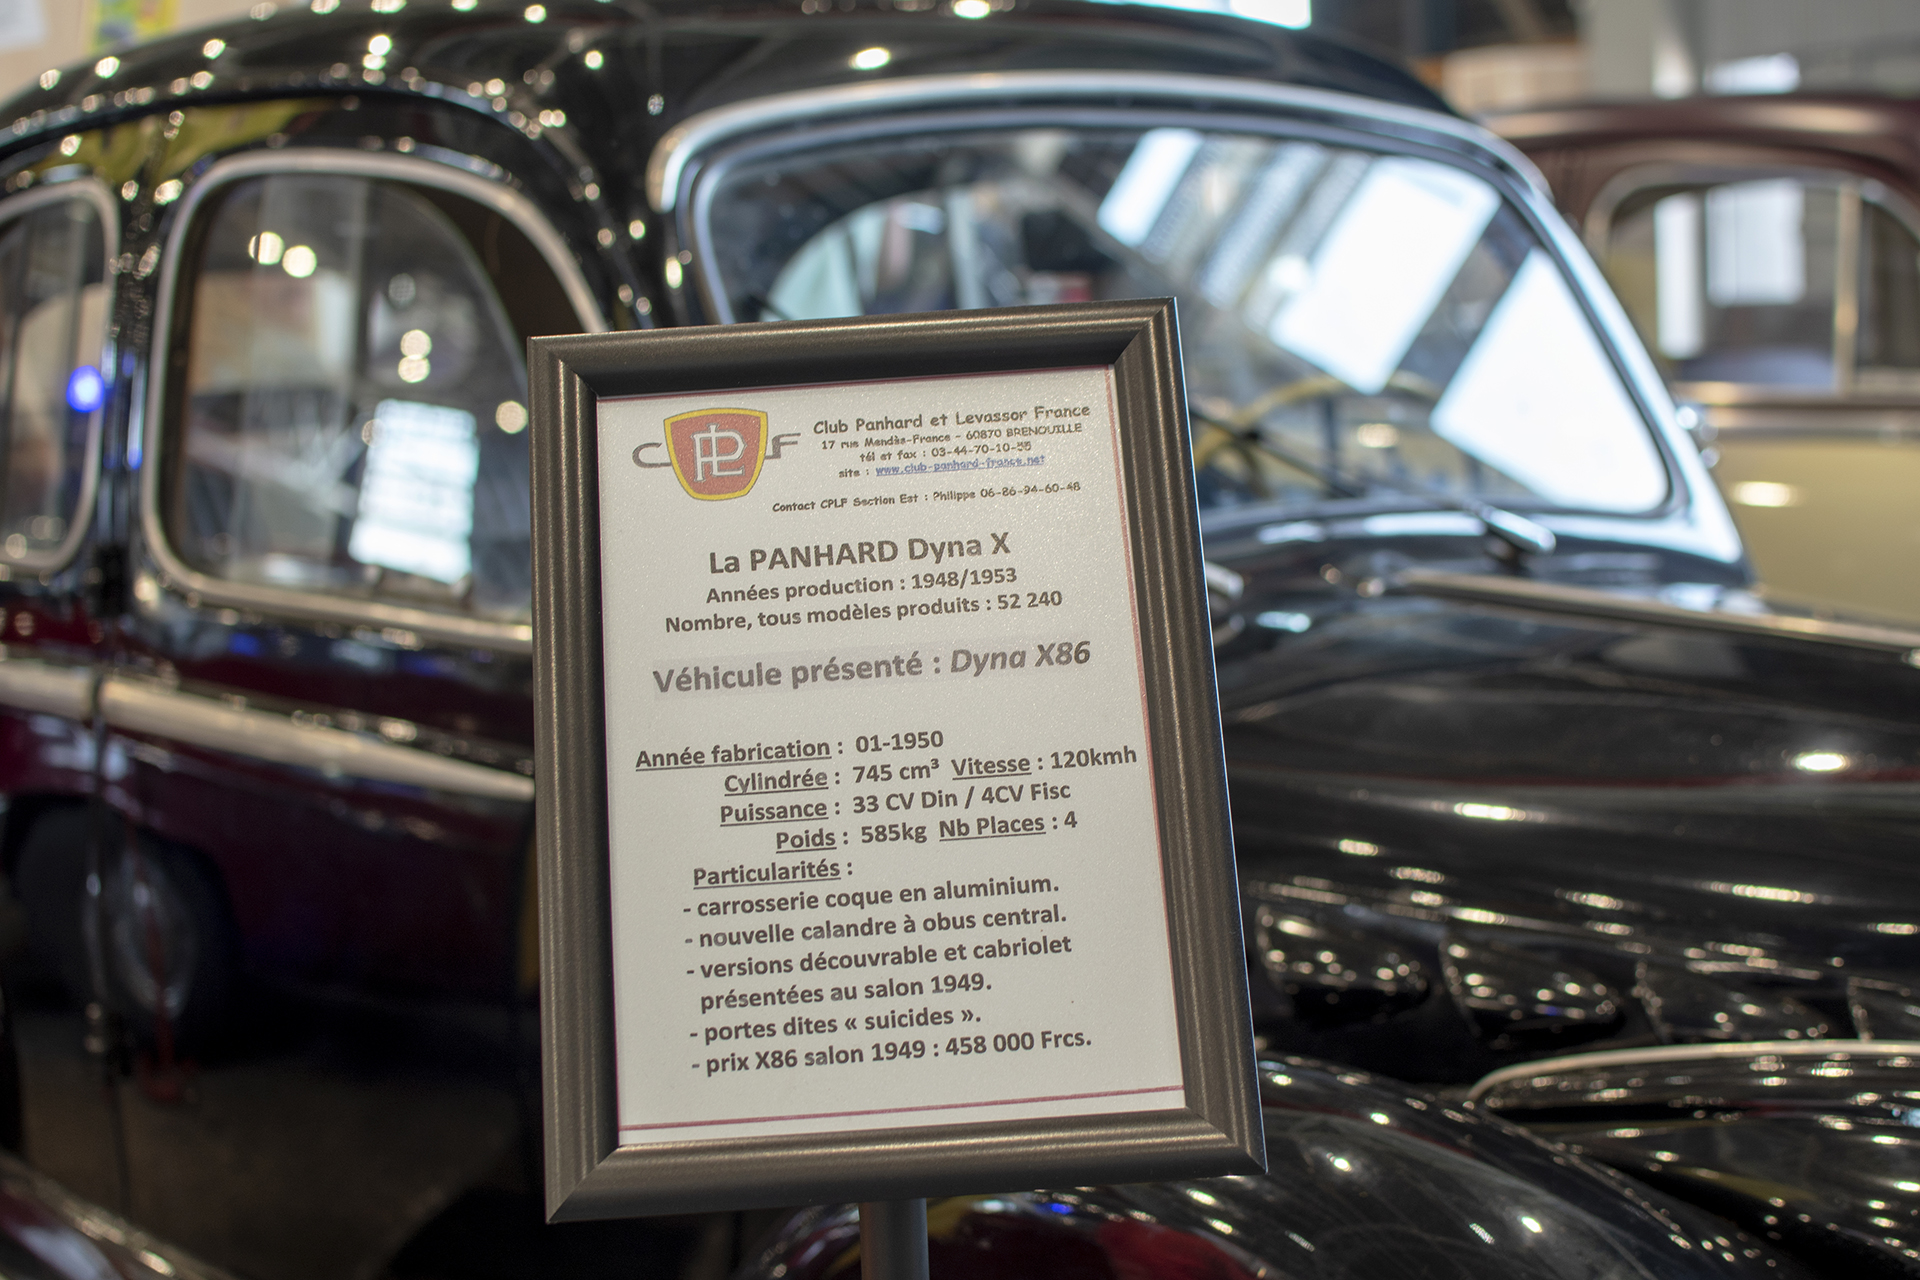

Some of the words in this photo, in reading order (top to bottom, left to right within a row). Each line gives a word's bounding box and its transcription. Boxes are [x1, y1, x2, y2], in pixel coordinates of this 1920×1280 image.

[813, 421, 848, 434] Club
[856, 415, 922, 432] Panhard
[930, 413, 947, 426] et
[956, 410, 1027, 424] Levassor
[1034, 405, 1090, 419] France
[822, 440, 834, 450] 17
[841, 440, 859, 449] rue
[865, 434, 950, 447] Mendès-France
[966, 429, 1002, 440] 60870
[1006, 423, 1082, 437] BRENOUILLE
[839, 468, 860, 478] site
[876, 455, 1045, 476] www.club-panhard-france.net
[860, 452, 875, 463] tél
[881, 452, 893, 460] et
[897, 450, 917, 460] fax
[772, 500, 816, 513] Contact
[820, 496, 848, 510] CPLF
[853, 493, 896, 507] Section
[899, 492, 918, 504] Est
[933, 489, 976, 503] Philippe
[980, 482, 1081, 499] 06-86-94-60-48
[710, 551, 740, 574] La
[750, 540, 898, 571] PANHARD
[908, 537, 982, 563] Dyna
[990, 532, 1011, 554] X
[707, 583, 779, 604] Années
[785, 577, 894, 602] production
[911, 567, 1017, 591] 1948/1953
[665, 612, 753, 633] Nombre,
[758, 607, 801, 627] tous
[807, 603, 892, 623] modèles
[897, 597, 980, 619] produits
[998, 593, 1022, 610] 52
[1028, 590, 1063, 609] 240
[653, 663, 782, 693] Véhicule
[792, 651, 923, 689] présenté
[950, 647, 1026, 677] Dyna
[1035, 640, 1091, 667] X86
[635, 748, 705, 770] Année
[711, 739, 831, 765] fabrication
[855, 730, 943, 754] 01-1950
[724, 769, 828, 795] Cylindrée
[853, 763, 892, 783] 745
[952, 755, 1032, 780] Vitesse
[1051, 746, 1137, 769] 120kmh
[720, 799, 828, 826] Puissance
[853, 794, 879, 814] 33
[886, 792, 913, 812] CV
[921, 790, 958, 809] Din
[981, 784, 1023, 804] 4CV
[1031, 781, 1071, 801] Fisc
[776, 830, 837, 853] Poids
[861, 823, 927, 844] 585kg
[939, 819, 970, 840] Nb
[976, 813, 1045, 837] Places
[1064, 811, 1077, 829] 4
[693, 858, 840, 889] Particularités
[697, 891, 819, 917] carrosserie
[825, 888, 893, 912] coque
[899, 884, 927, 902] en
[933, 875, 1059, 900] aluminium.
[699, 921, 795, 947] nouvelle
[801, 916, 897, 941] calandre
[904, 914, 917, 934] à
[923, 910, 976, 932] obus
[983, 905, 1067, 928] central.
[700, 955, 794, 978] versions
[800, 944, 938, 972] découvrable
[944, 942, 968, 961] et
[973, 935, 1072, 958] cabriolet
[700, 984, 824, 1013] présentées
[830, 983, 858, 1001] au
[864, 976, 924, 998] salon
[931, 972, 992, 994] 1949.
[704, 1019, 777, 1045] portes
[783, 1014, 838, 1037] dites
[864, 1007, 954, 1031] suicides
[706, 1051, 750, 1076] prix
[755, 1049, 798, 1070] X86
[804, 1043, 864, 1066] salon
[872, 1040, 926, 1062] 1949
[946, 1035, 987, 1056] 458
[993, 1031, 1035, 1051] 000
[1041, 1028, 1092, 1049] Frcs.
